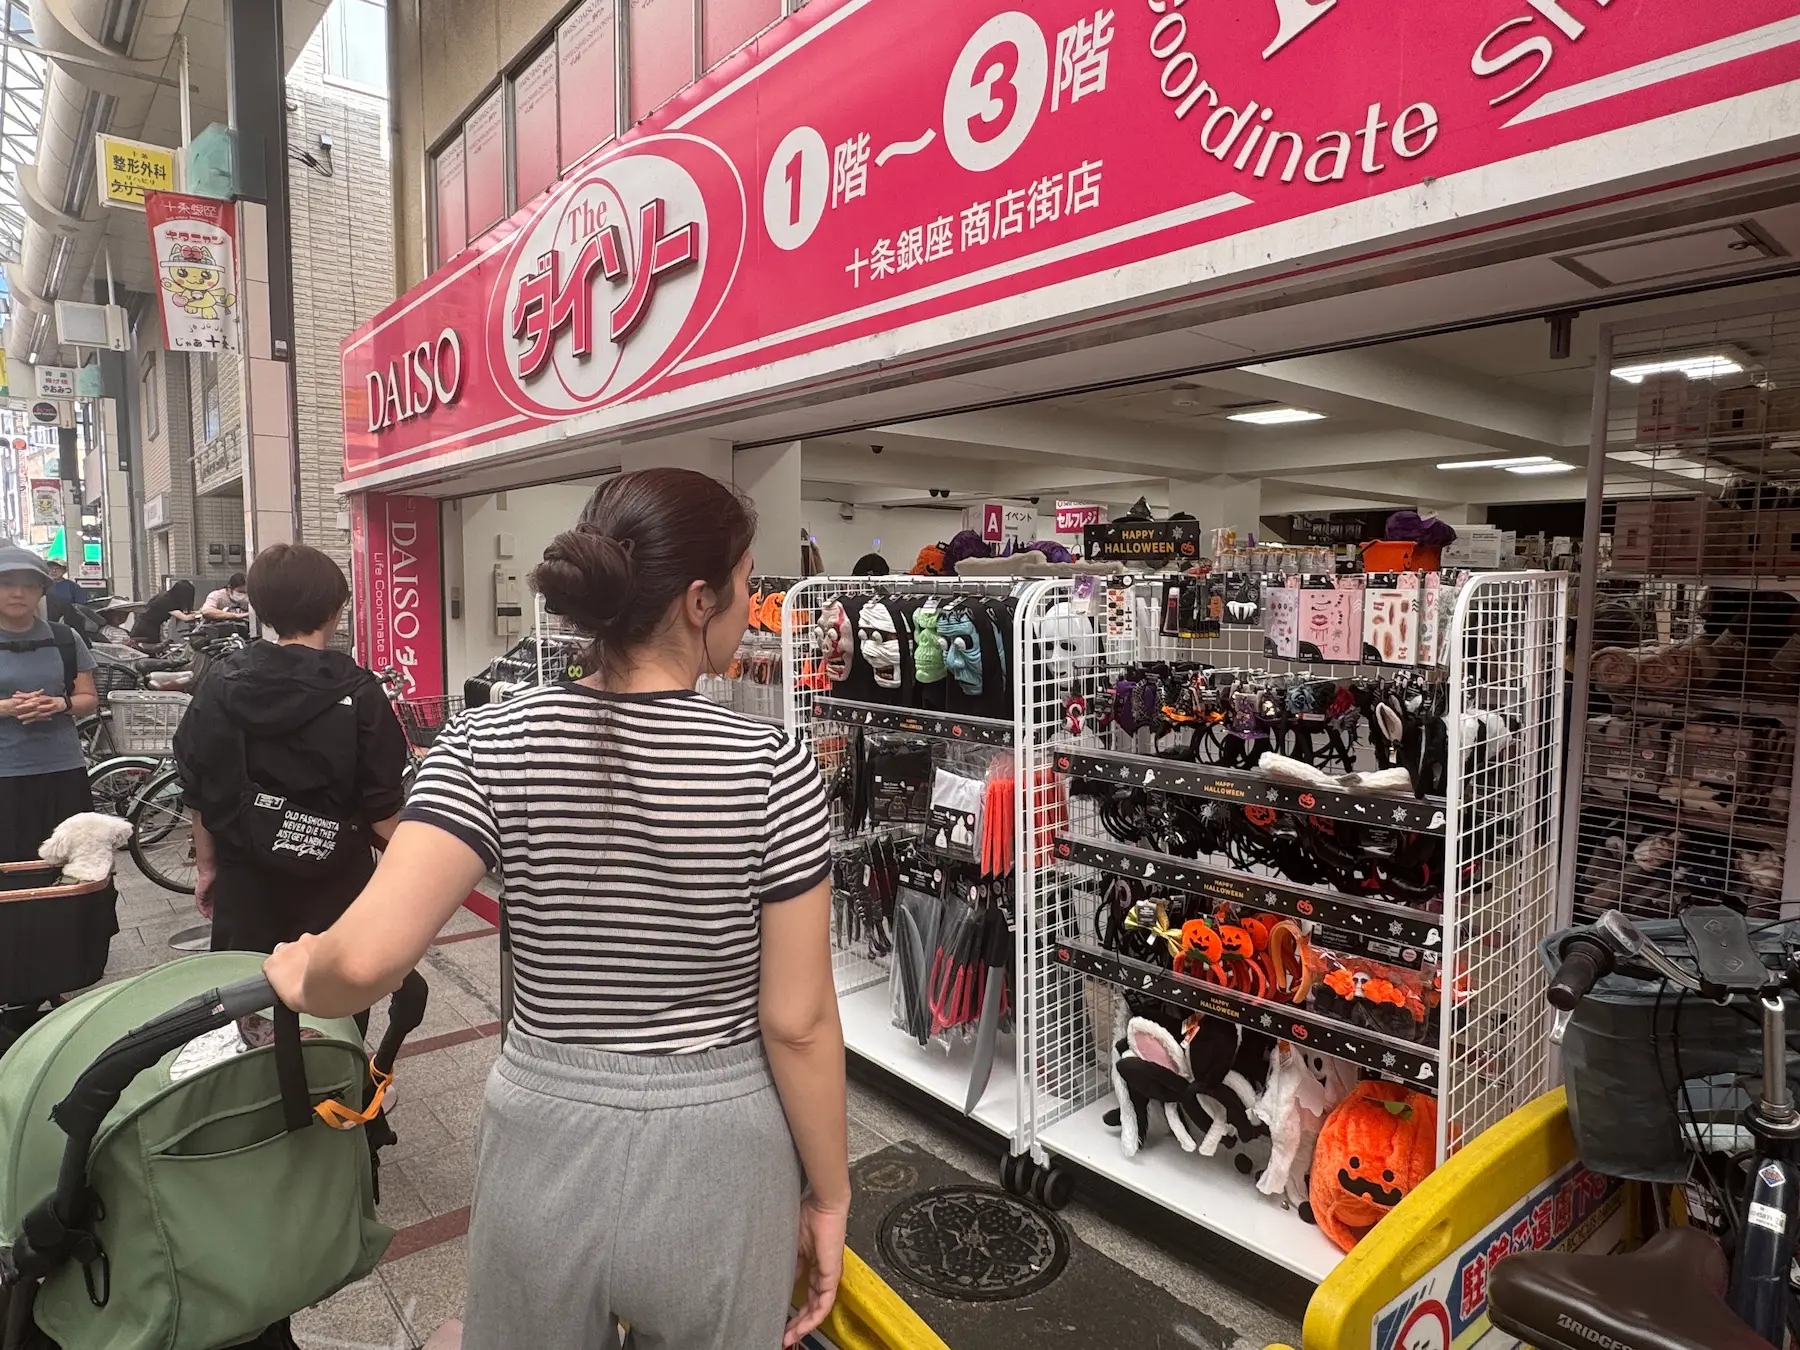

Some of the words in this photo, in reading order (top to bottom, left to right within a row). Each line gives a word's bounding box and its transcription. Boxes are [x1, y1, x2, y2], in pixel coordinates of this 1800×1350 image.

[112, 154, 167, 181] 整形外科
[164, 200, 217, 217] 十条銀座
[566, 198, 608, 245] The
[844, 159, 1103, 288] 十条銀座商店街店
[511, 197, 699, 384] ダイソー
[366, 328, 463, 434] DAISO
[987, 512, 999, 533] A
[1005, 511, 1032, 522] イベント
[1056, 511, 1097, 529] セルフレジ
[1121, 529, 1155, 540] HAPPY
[1104, 542, 1175, 554] HALLOWEEN
[373, 552, 383, 576] Life
[391, 521, 420, 639] DAISO
[374, 579, 385, 652] Coordinate
[395, 645, 418, 695] ダイ
[1204, 785, 1245, 797] HALLOWEEN
[1215, 780, 1235, 788] HAPPY
[282, 820, 306, 833] NEVER
[305, 825, 320, 836] DIE
[320, 829, 337, 840] THEY
[284, 810, 300, 821] OLD
[299, 813, 340, 832] FASHIONISTA
[276, 829, 293, 840] JUST
[291, 832, 305, 843] GET
[322, 840, 337, 851] AGE
[1203, 883, 1245, 899] HALLOWEEN
[1214, 879, 1234, 889] HAPPY
[1200, 1000, 1240, 1019] HALLOWEEN
[1210, 997, 1230, 1008] HAPPY
